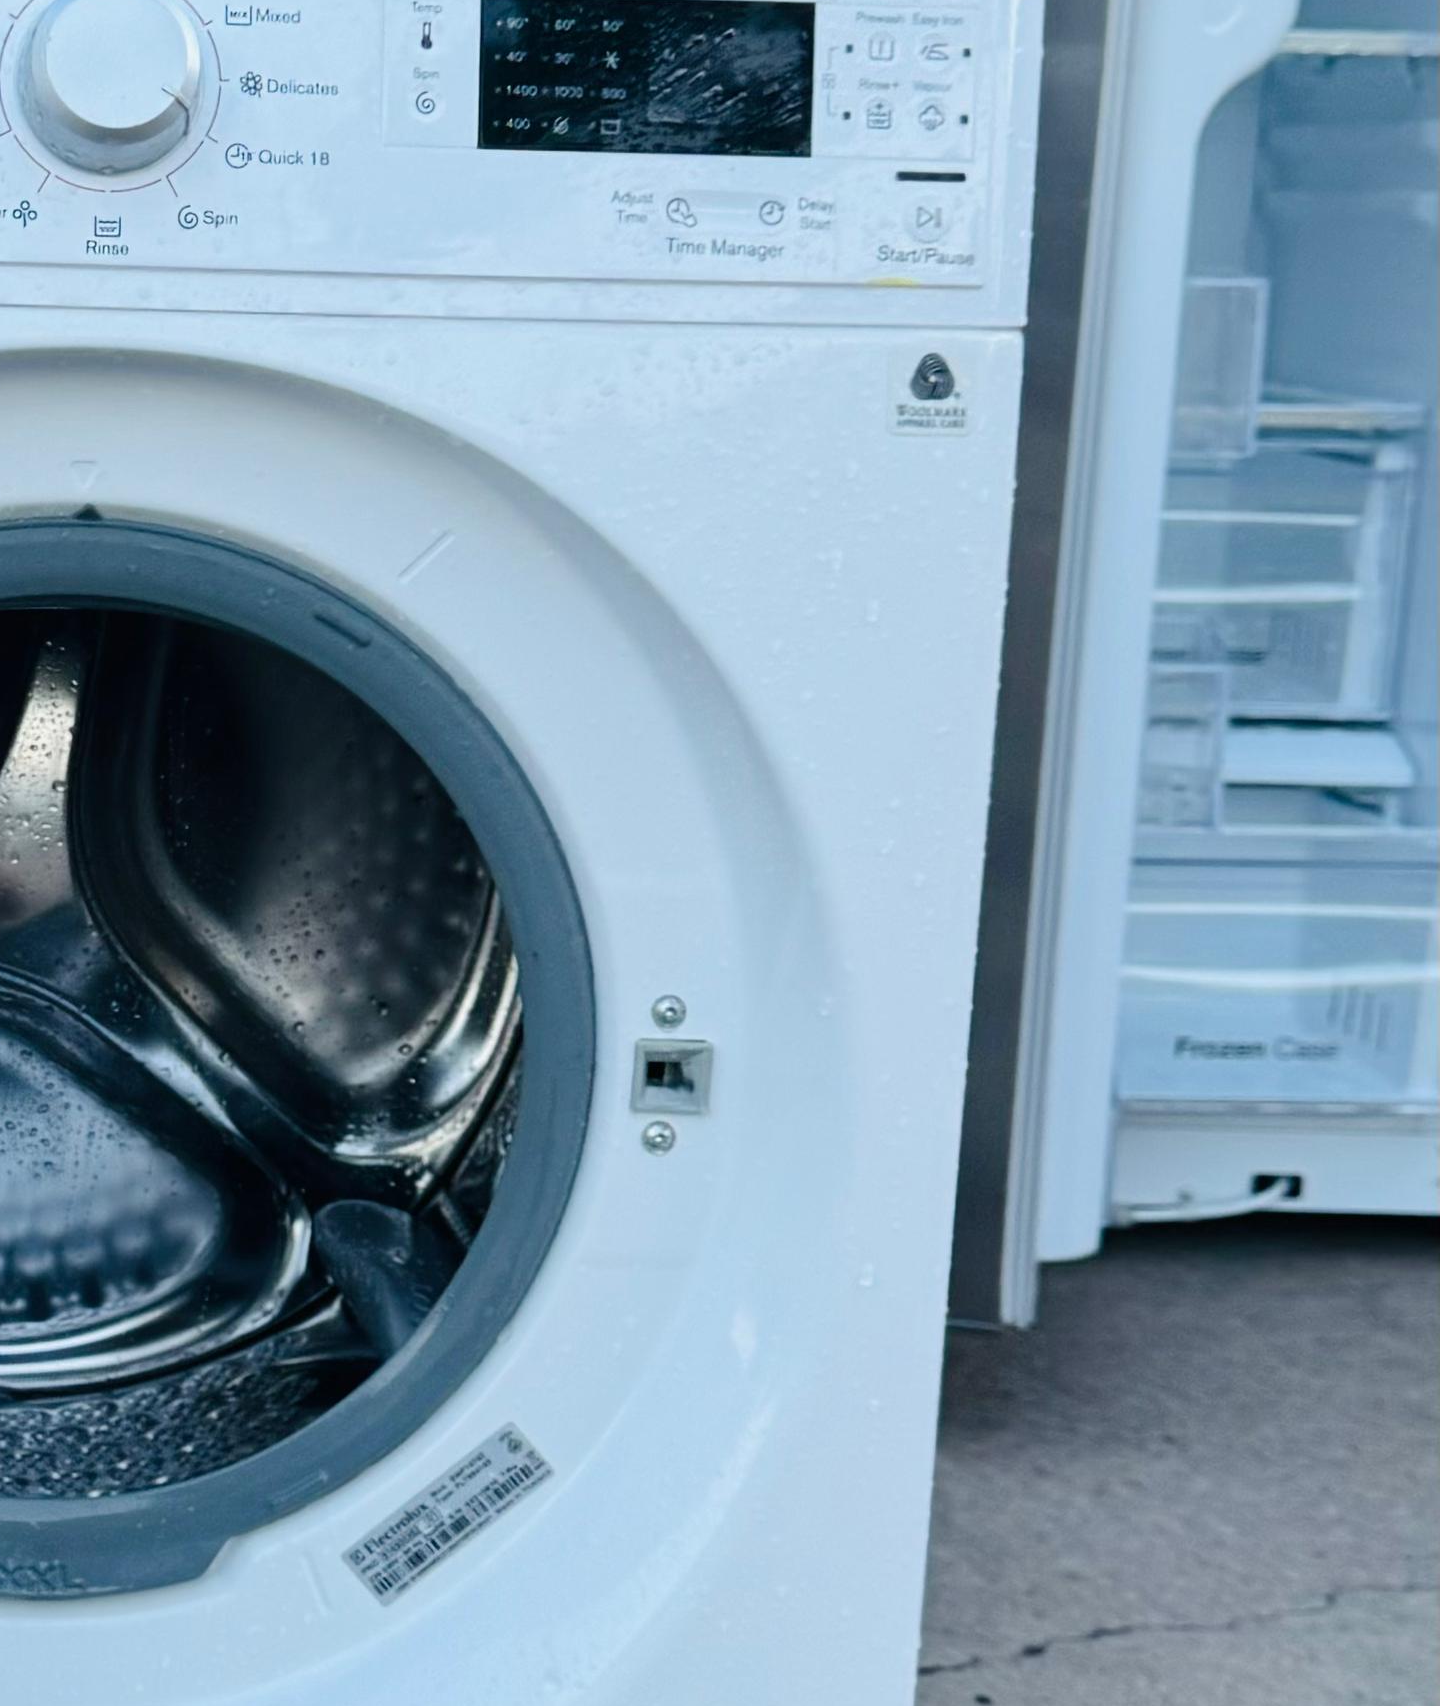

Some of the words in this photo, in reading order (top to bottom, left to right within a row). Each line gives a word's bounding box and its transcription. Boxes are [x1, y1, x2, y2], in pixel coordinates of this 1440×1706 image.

[255, 8, 302, 24] Mixed
[412, 0, 443, 15] Temp
[266, 78, 340, 96] Delicates
[506, 117, 531, 130] 400
[258, 149, 304, 166] Quick
[611, 189, 655, 207] Adjust
[797, 196, 836, 214] Delay
[202, 209, 239, 229] Spin
[616, 209, 649, 224] Time
[799, 216, 833, 231] Start
[85, 239, 130, 256] Rinse
[665, 236, 706, 256] Time
[711, 239, 785, 259] Manager
[875, 244, 976, 267] Start/Pause
[363, 1503, 429, 1555] Electrolux
